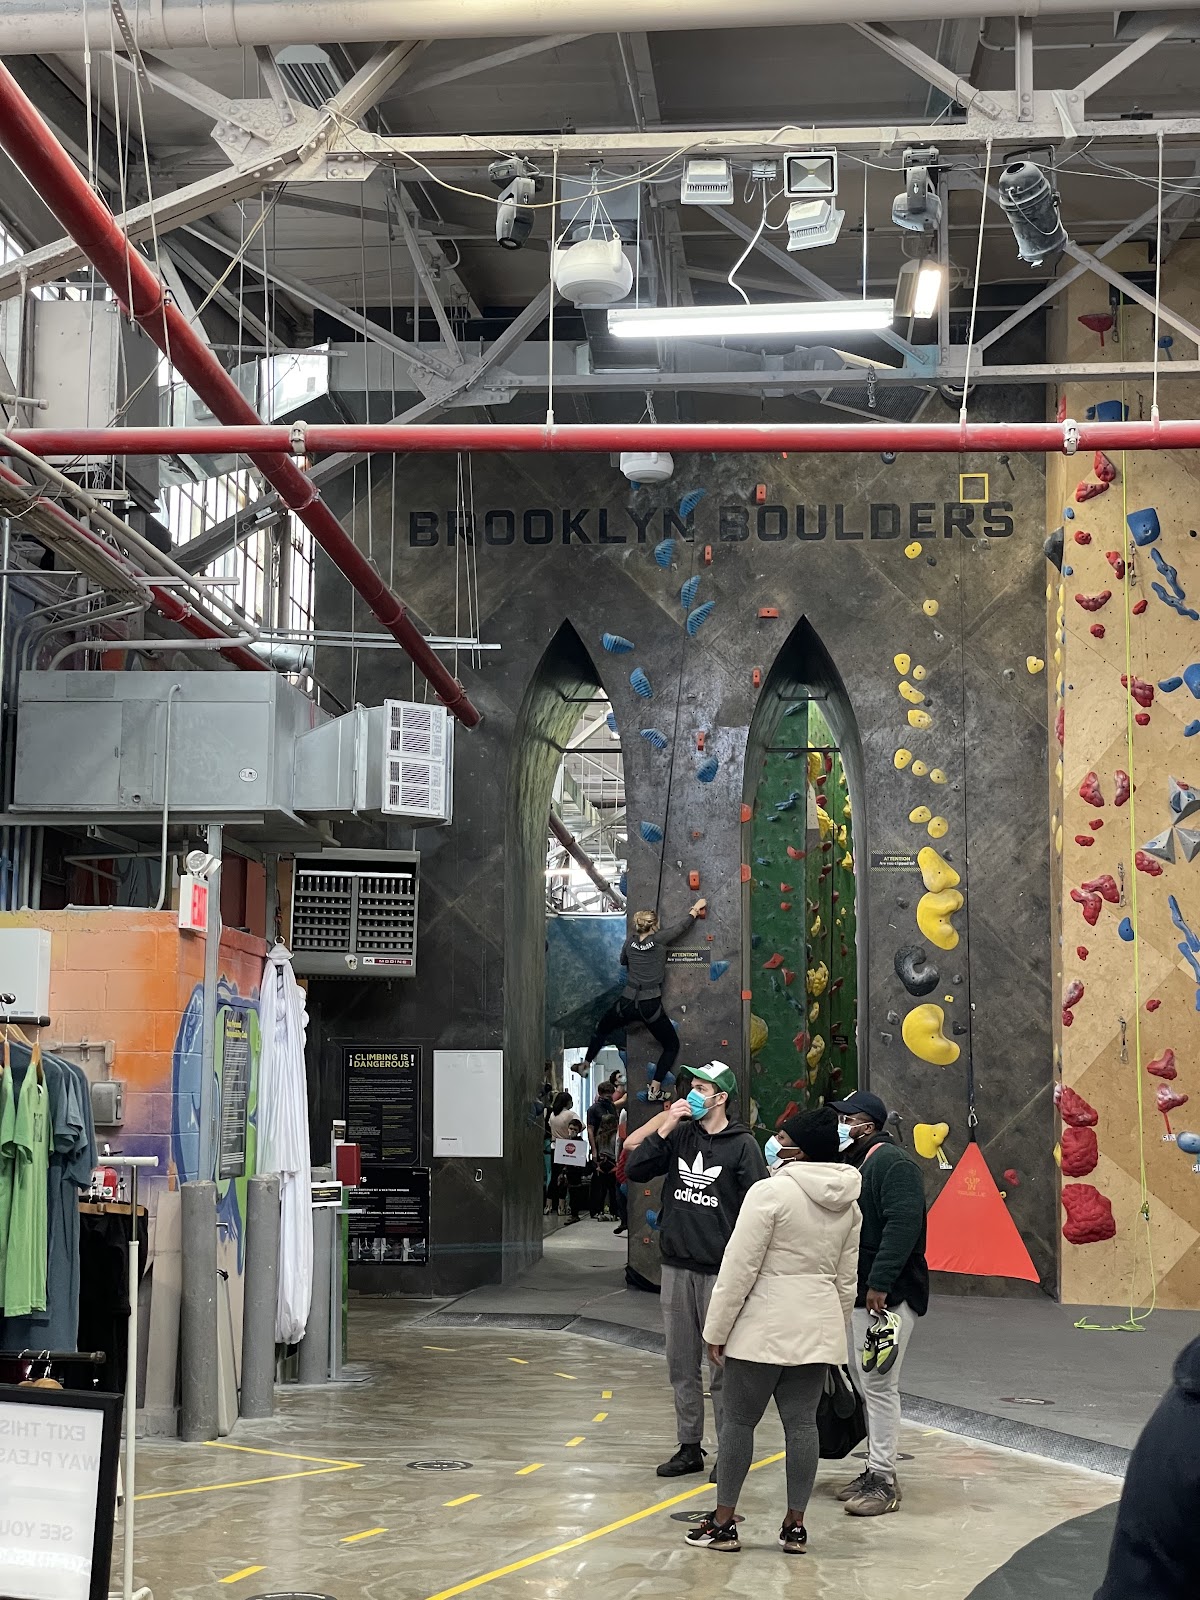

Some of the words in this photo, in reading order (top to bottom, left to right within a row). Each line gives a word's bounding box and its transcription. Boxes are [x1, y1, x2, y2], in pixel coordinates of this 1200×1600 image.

[409, 508, 695, 547] BROOKLYN
[719, 501, 1014, 541] BOULDERS
[355, 1053, 398, 1061] CLIMBING
[400, 1053, 409, 1061] IS
[353, 1060, 410, 1068] DANGEROUS
[674, 1188, 719, 1207] adidas
